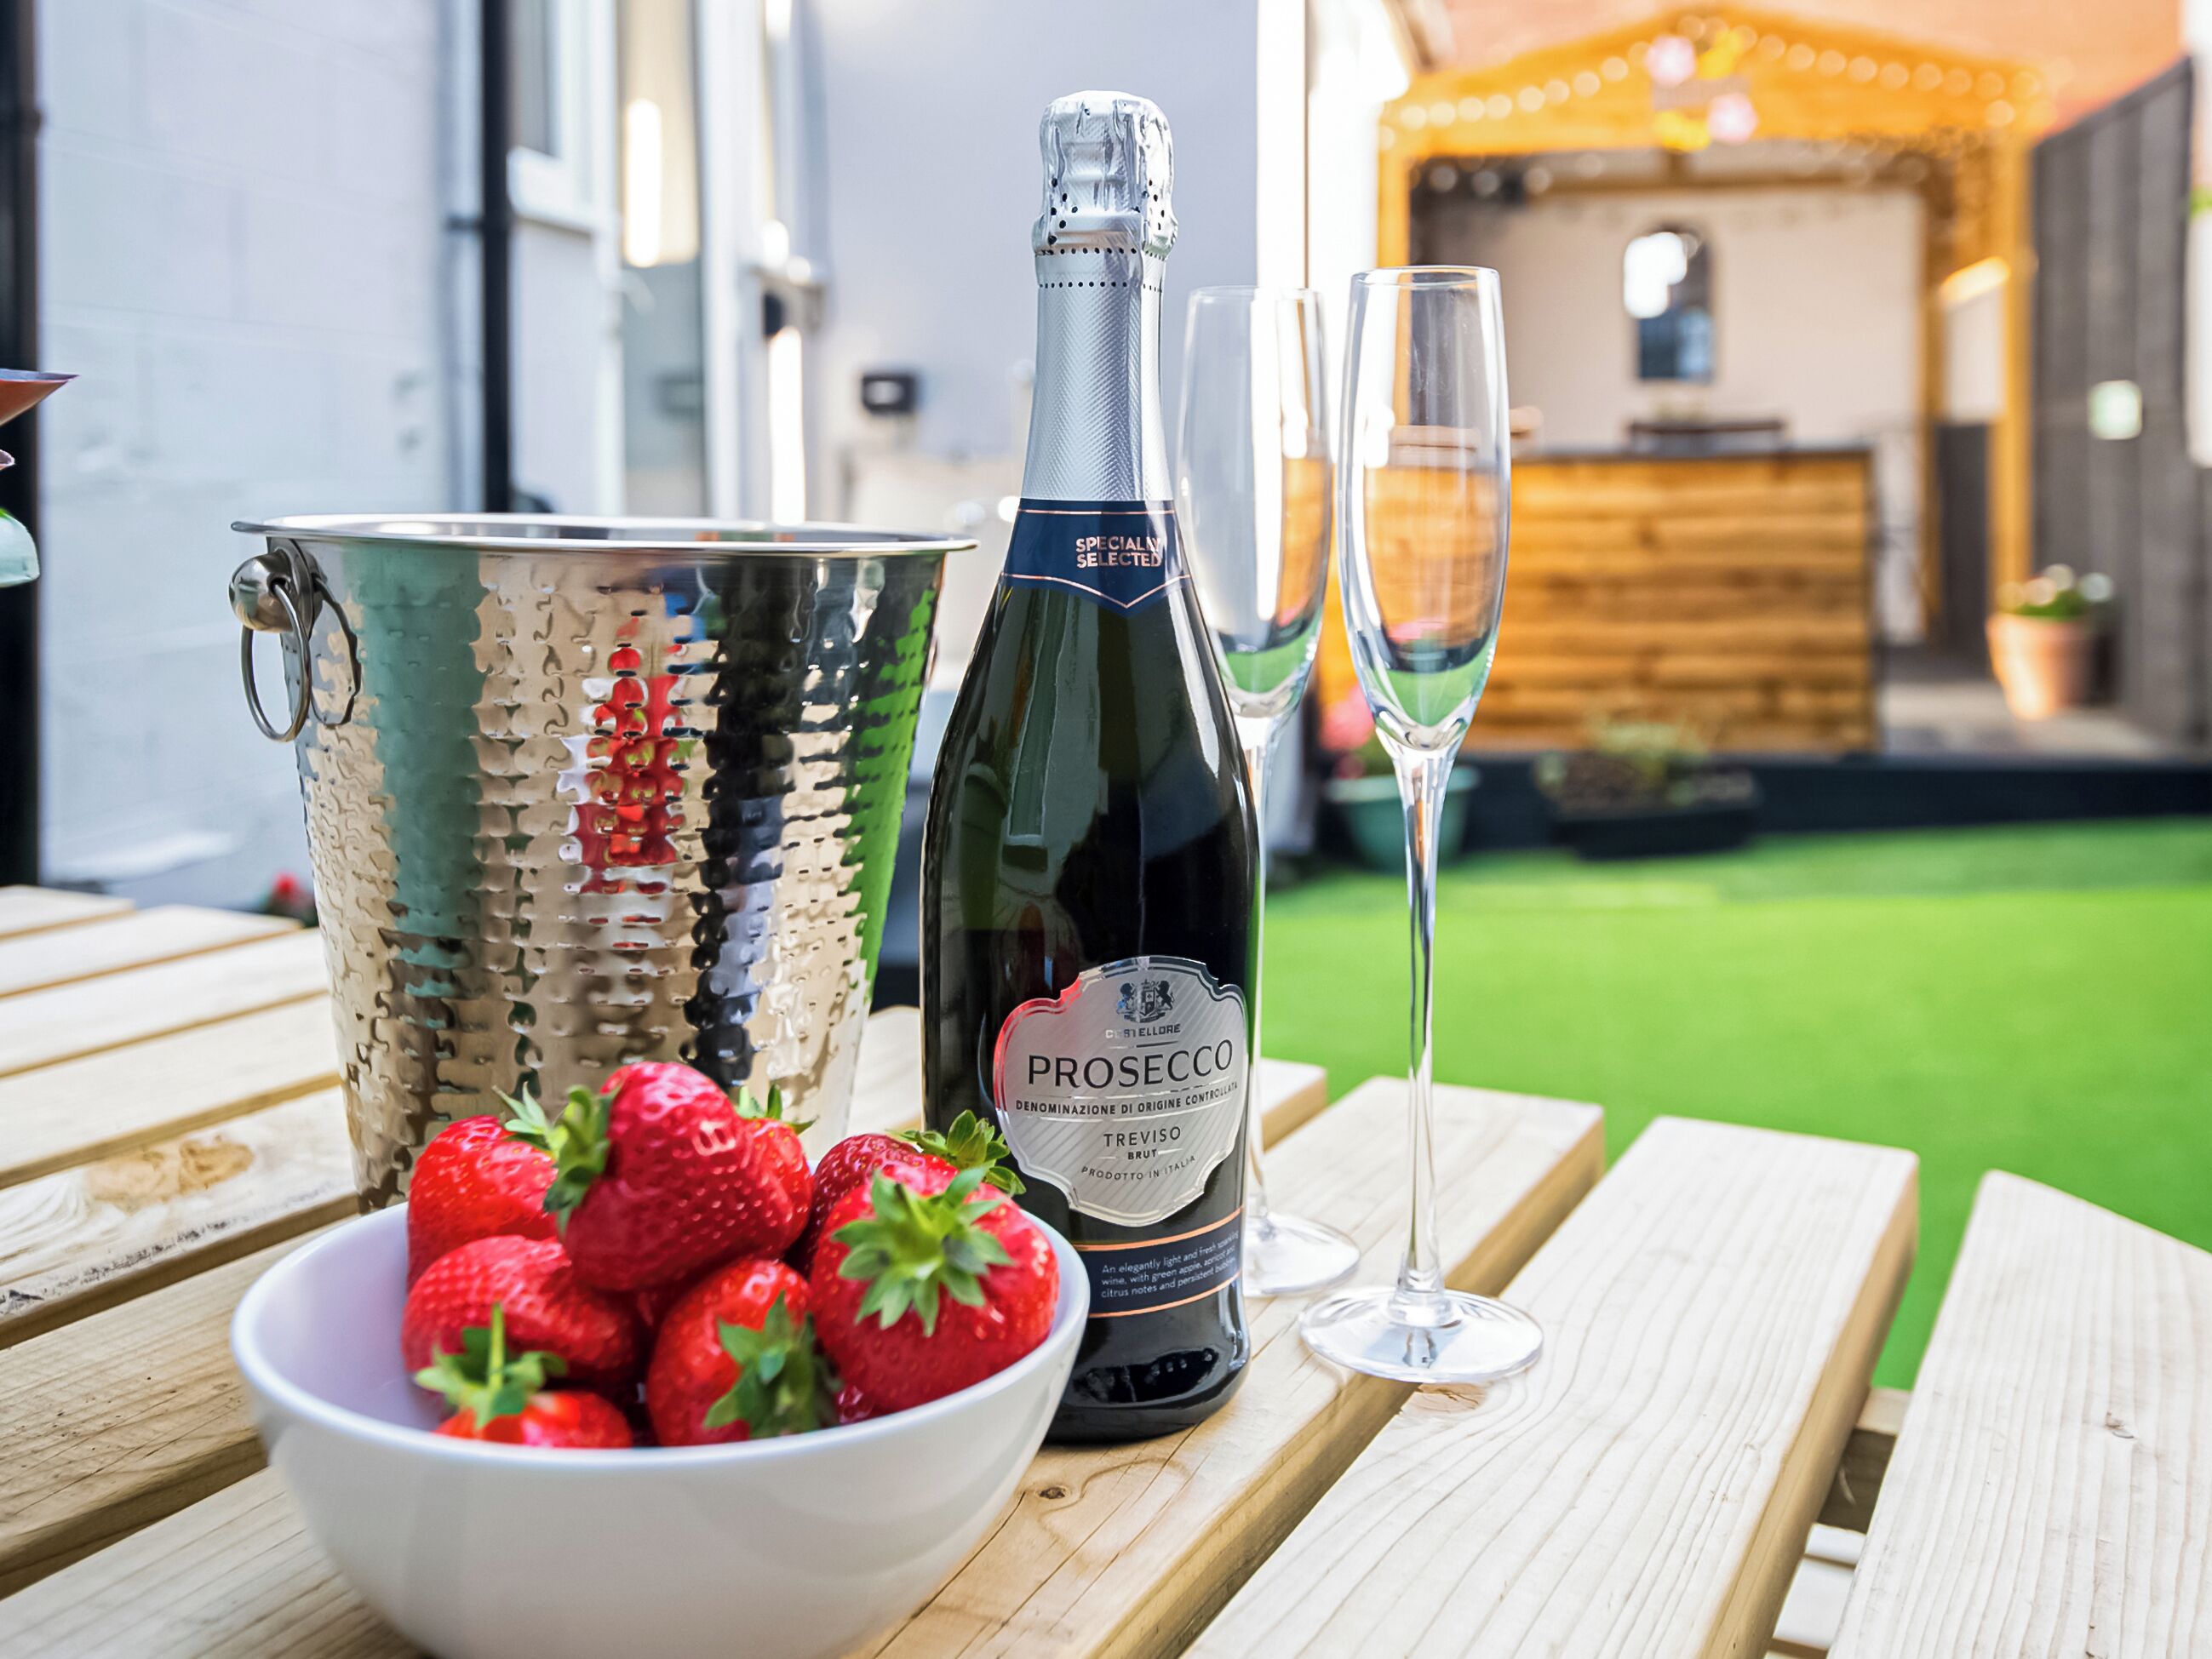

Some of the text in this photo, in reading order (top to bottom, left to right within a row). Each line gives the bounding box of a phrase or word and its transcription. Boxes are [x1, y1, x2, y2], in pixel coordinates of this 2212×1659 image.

[1076, 552, 1162, 569] SELECTED
[1105, 1023, 1181, 1038] CSTELLORE
[1028, 1039, 1233, 1089] PROSECCO
[1016, 1100, 1115, 1115] DENOMINAZIONE
[1121, 1103, 1132, 1114] DI
[1138, 1097, 1182, 1113] ORIGINE
[1103, 1126, 1181, 1147] TREVISO
[1127, 1148, 1157, 1160] BRUT
[1080, 1165, 1143, 1181] PRODOTTO
[1149, 1169, 1160, 1179] IN
[1102, 1264, 1116, 1273] An
[1118, 1258, 1161, 1274] elegantly
[1163, 1255, 1182, 1267] light
[1183, 1248, 1198, 1261] and
[1130, 1270, 1149, 1284] with
[1151, 1268, 1178, 1283] green
[1101, 1288, 1129, 1298] citrus
[1131, 1284, 1158, 1295] notes
[1159, 1277, 1176, 1290] and
